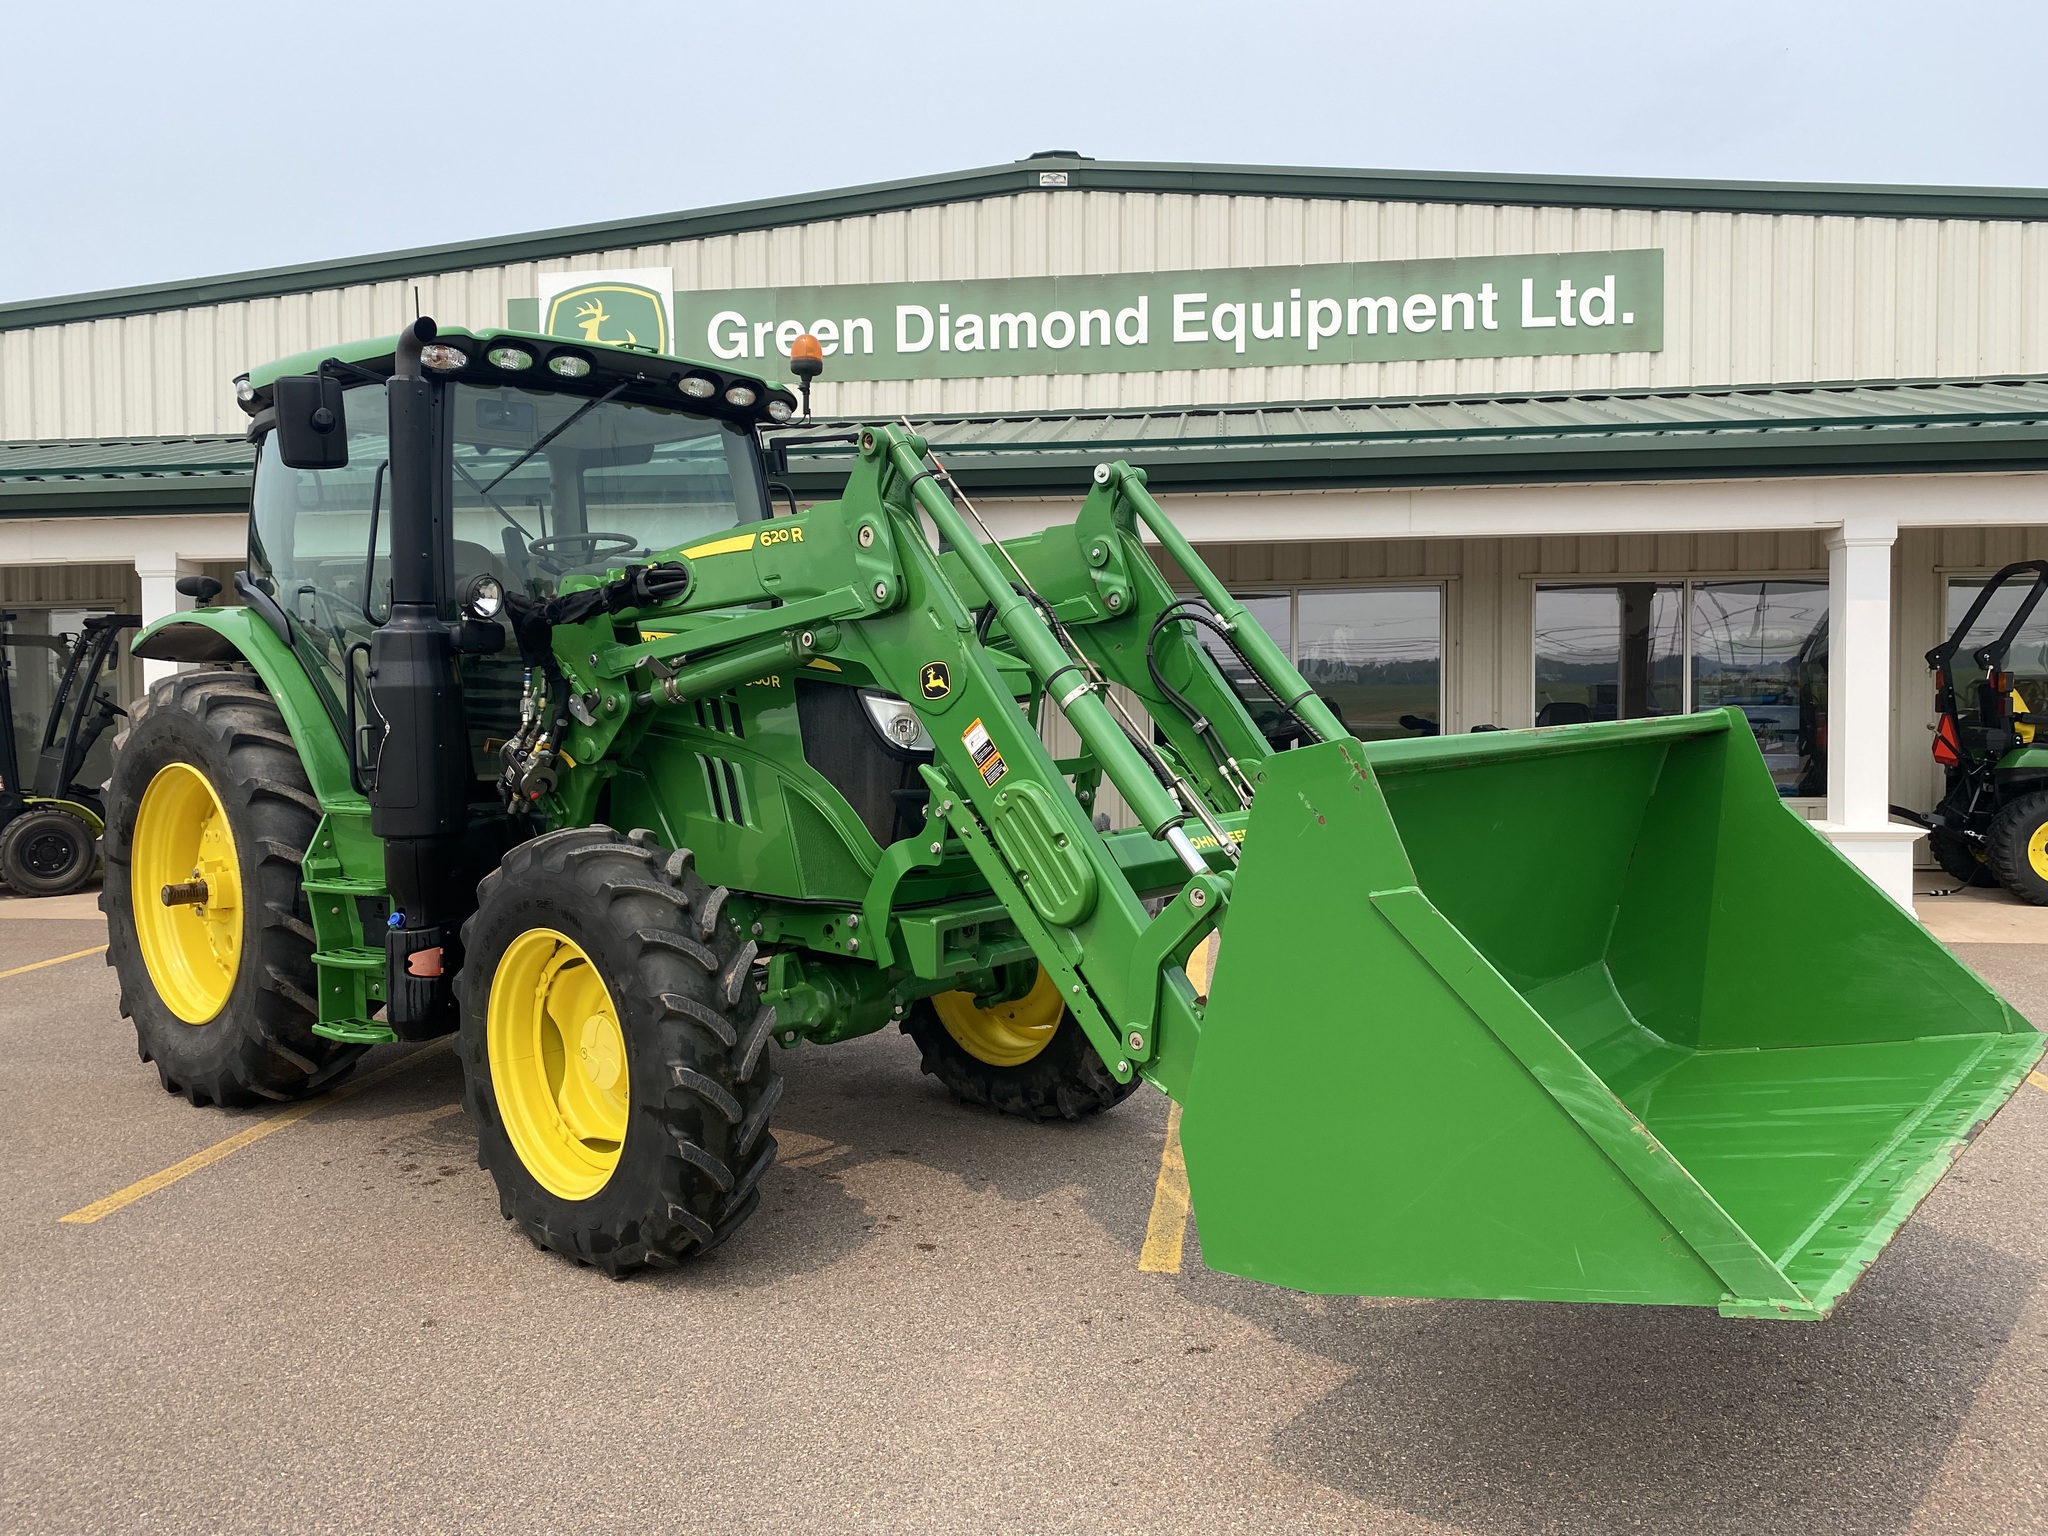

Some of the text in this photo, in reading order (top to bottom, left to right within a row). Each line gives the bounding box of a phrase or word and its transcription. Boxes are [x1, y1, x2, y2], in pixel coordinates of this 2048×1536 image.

[707, 275, 1635, 360] Green Diamond Equipment Ltd.
